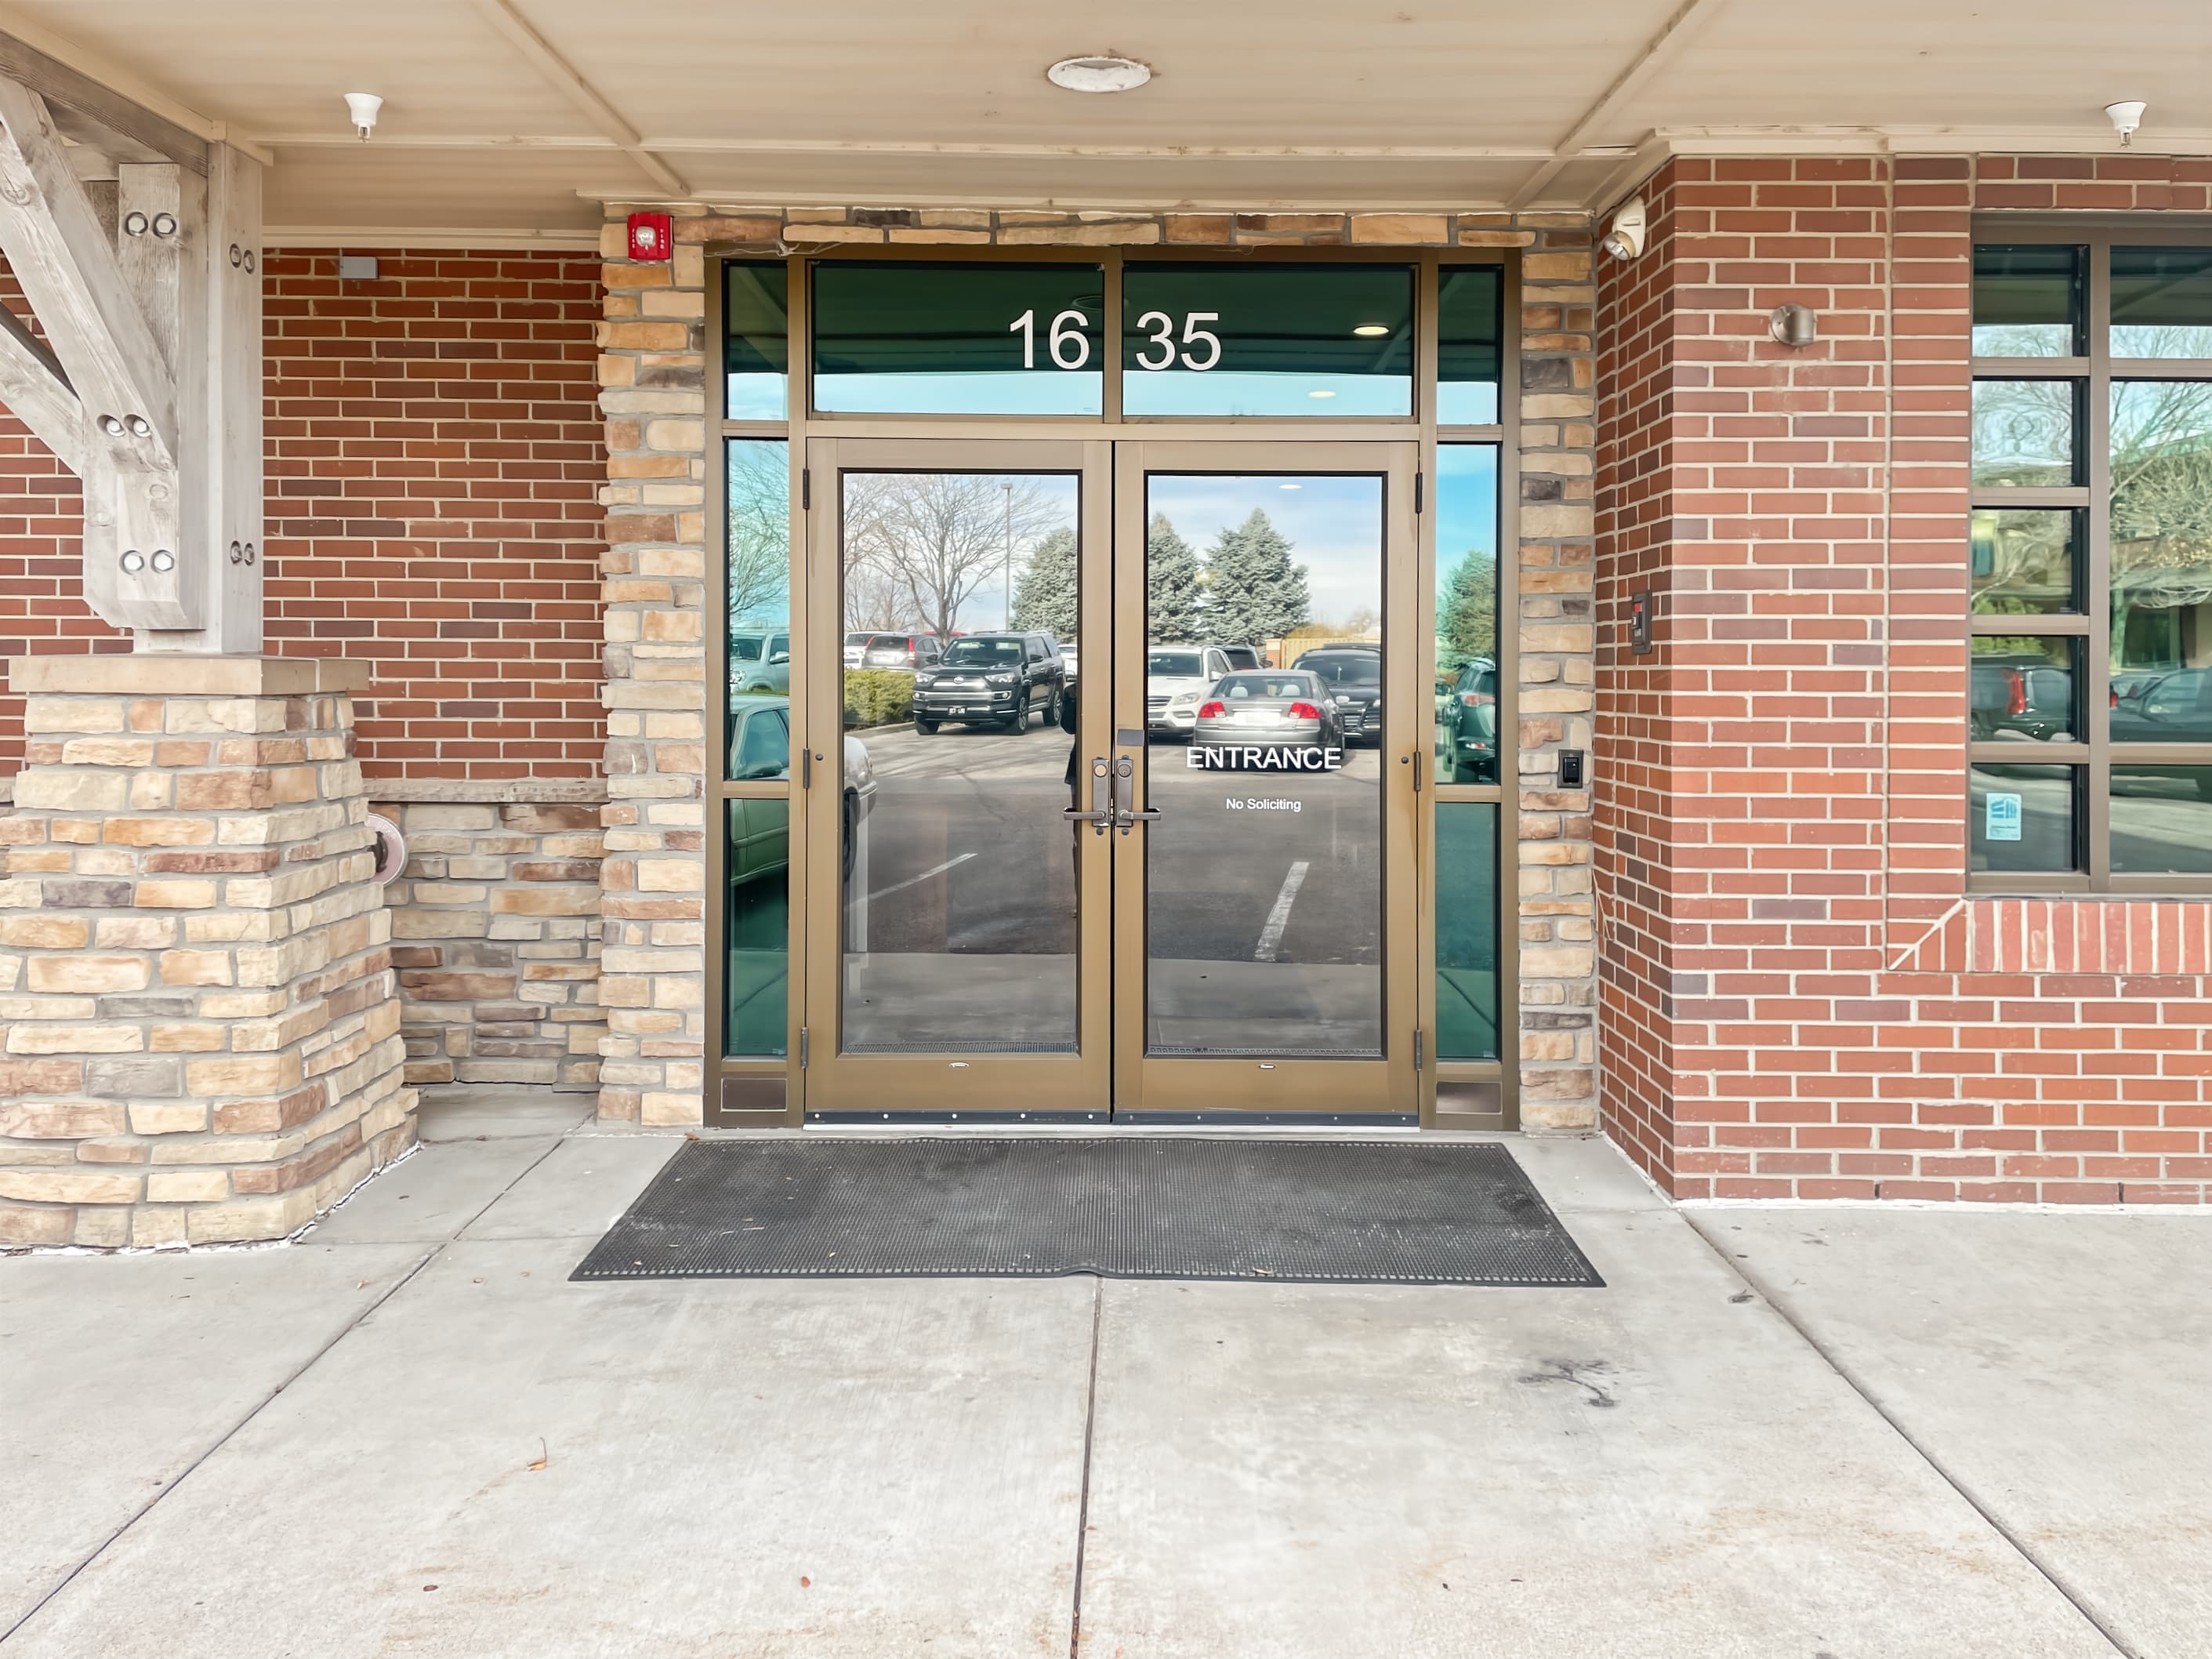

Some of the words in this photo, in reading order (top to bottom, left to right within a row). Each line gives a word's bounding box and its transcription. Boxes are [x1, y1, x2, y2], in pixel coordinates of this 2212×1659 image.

[1010, 310, 1090, 370] 16
[1136, 311, 1222, 372] 35
[1186, 746, 1342, 770] ENTRANCE
[1226, 797, 1244, 810] No
[1246, 797, 1302, 812] Soliciting
